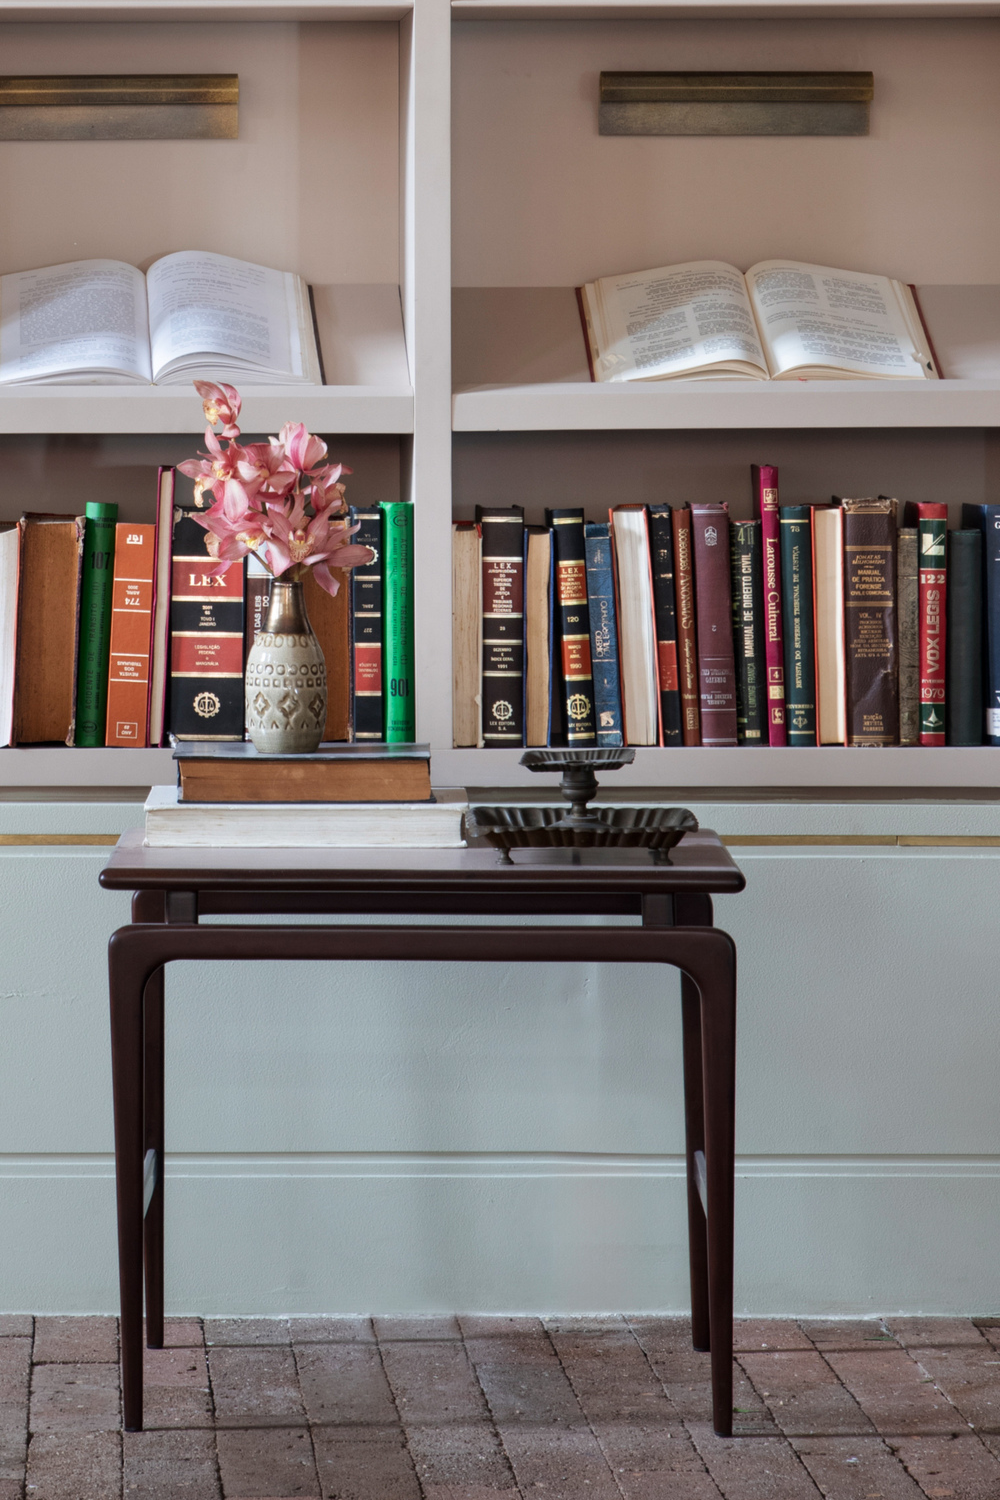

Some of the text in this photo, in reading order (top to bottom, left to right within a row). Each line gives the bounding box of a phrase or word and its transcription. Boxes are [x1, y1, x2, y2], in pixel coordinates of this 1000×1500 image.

[90, 551, 111, 570] 107
[189, 574, 227, 587] LEX
[920, 573, 946, 585] 122
[766, 537, 781, 642] Larousse Cultural
[124, 597, 141, 606] 774
[262, 595, 270, 607] DO
[741, 552, 755, 658] MANUAL DE DIREITO CIVIL
[254, 595, 262, 628] DAS LEIS
[926, 589, 940, 674] VOX LEGIS
[772, 670, 780, 679] 4
[921, 687, 945, 699] 1979
